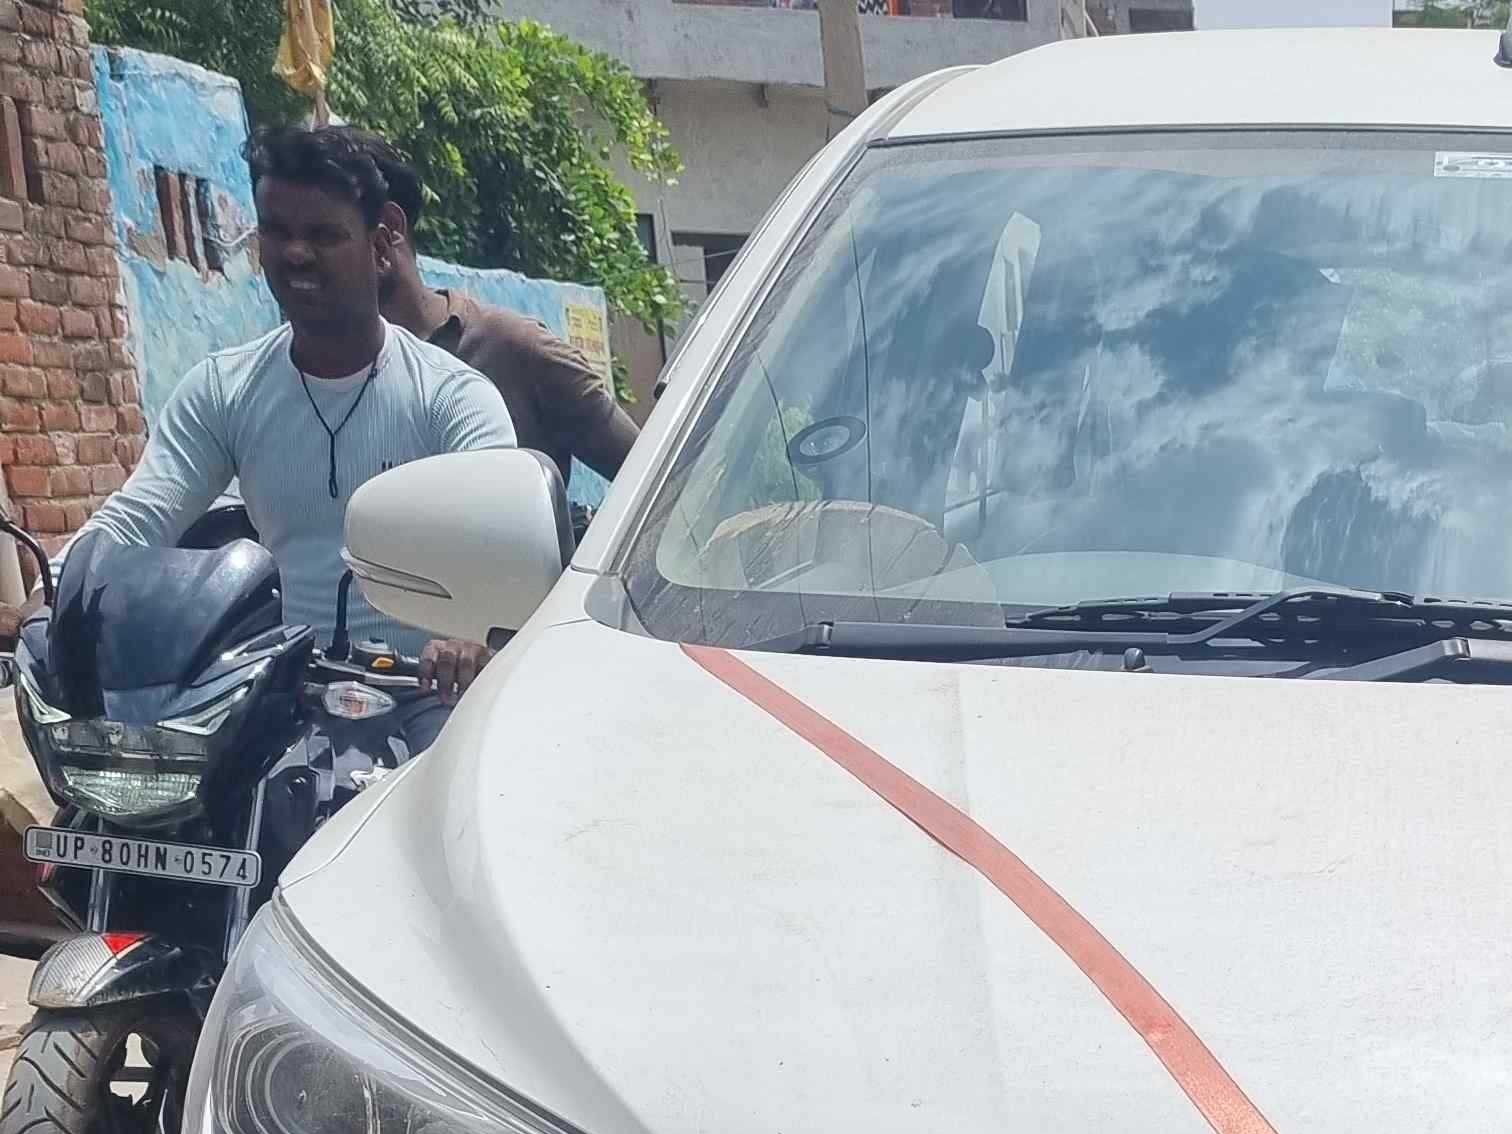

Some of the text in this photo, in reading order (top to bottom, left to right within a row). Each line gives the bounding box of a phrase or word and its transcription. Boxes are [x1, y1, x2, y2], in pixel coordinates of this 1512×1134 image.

[56, 833, 248, 881] UP 80HN 0574
